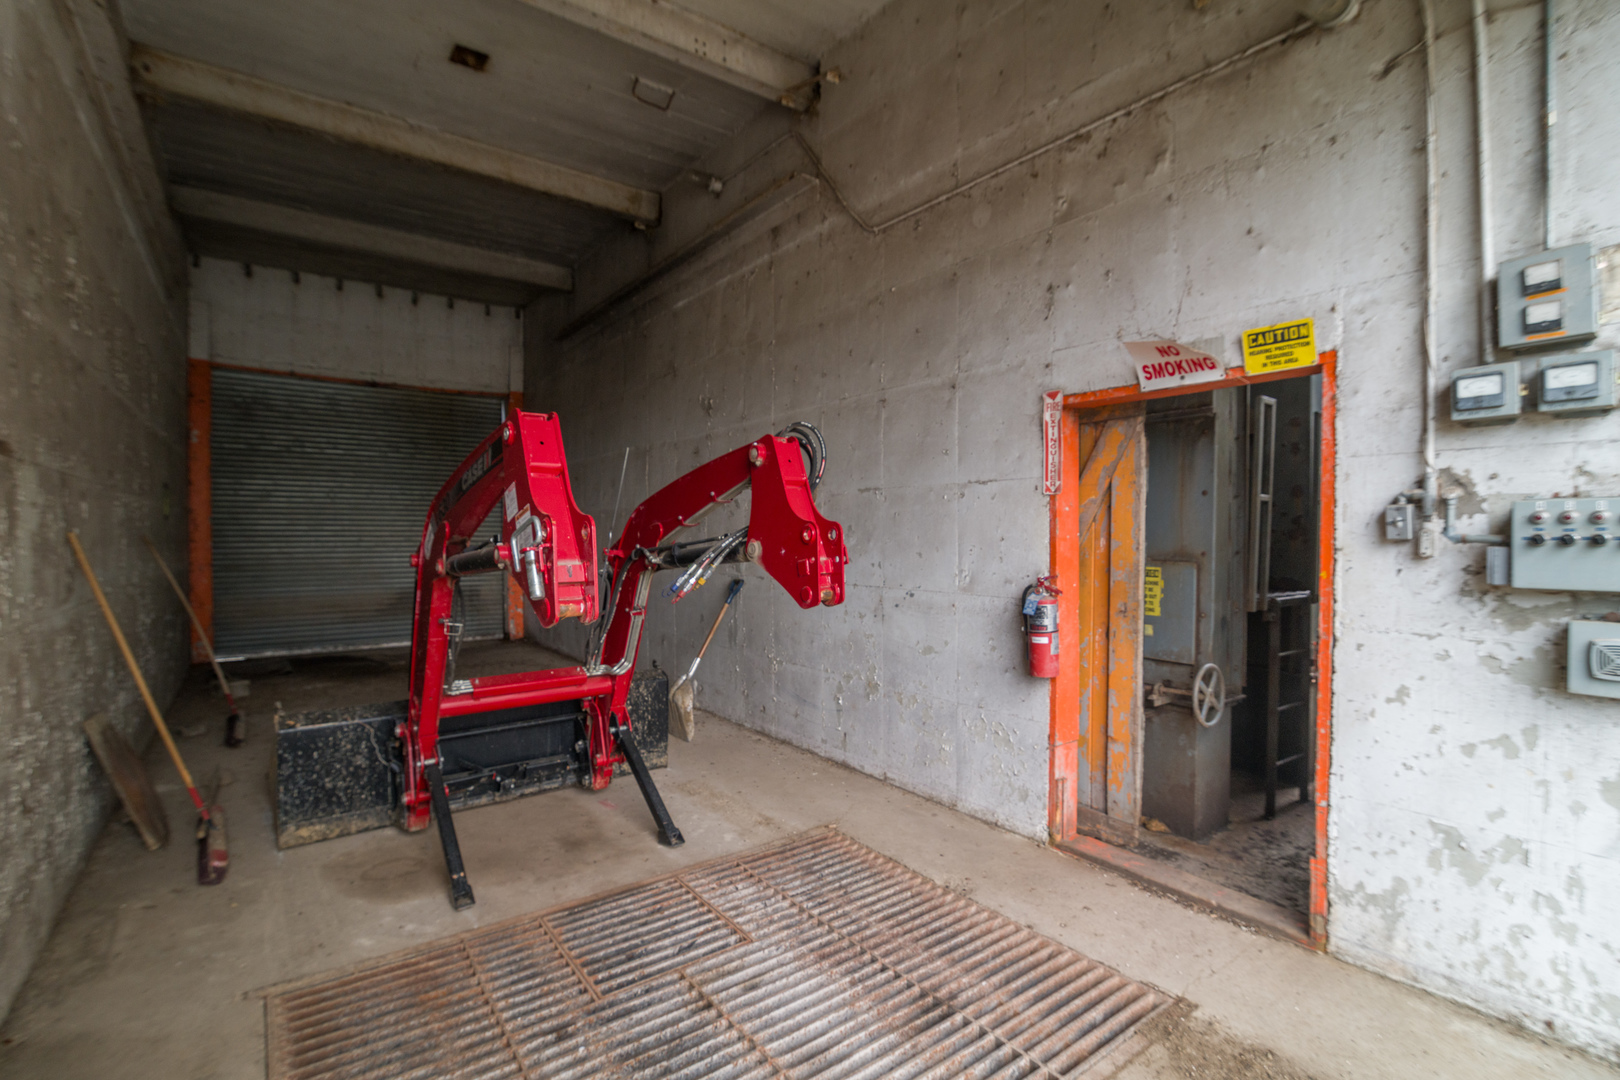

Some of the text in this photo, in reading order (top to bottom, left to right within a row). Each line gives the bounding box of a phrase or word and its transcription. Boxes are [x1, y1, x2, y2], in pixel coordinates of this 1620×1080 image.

[1248, 323, 1309, 347] CAUTION
[1155, 345, 1181, 358] NO
[1249, 341, 1310, 356] HEARING PROTECTION
[1265, 351, 1294, 360] REQUIRED
[1142, 357, 1217, 380] SMOKING
[1046, 402, 1061, 412] FIRE
[462, 456, 483, 490] CASE
